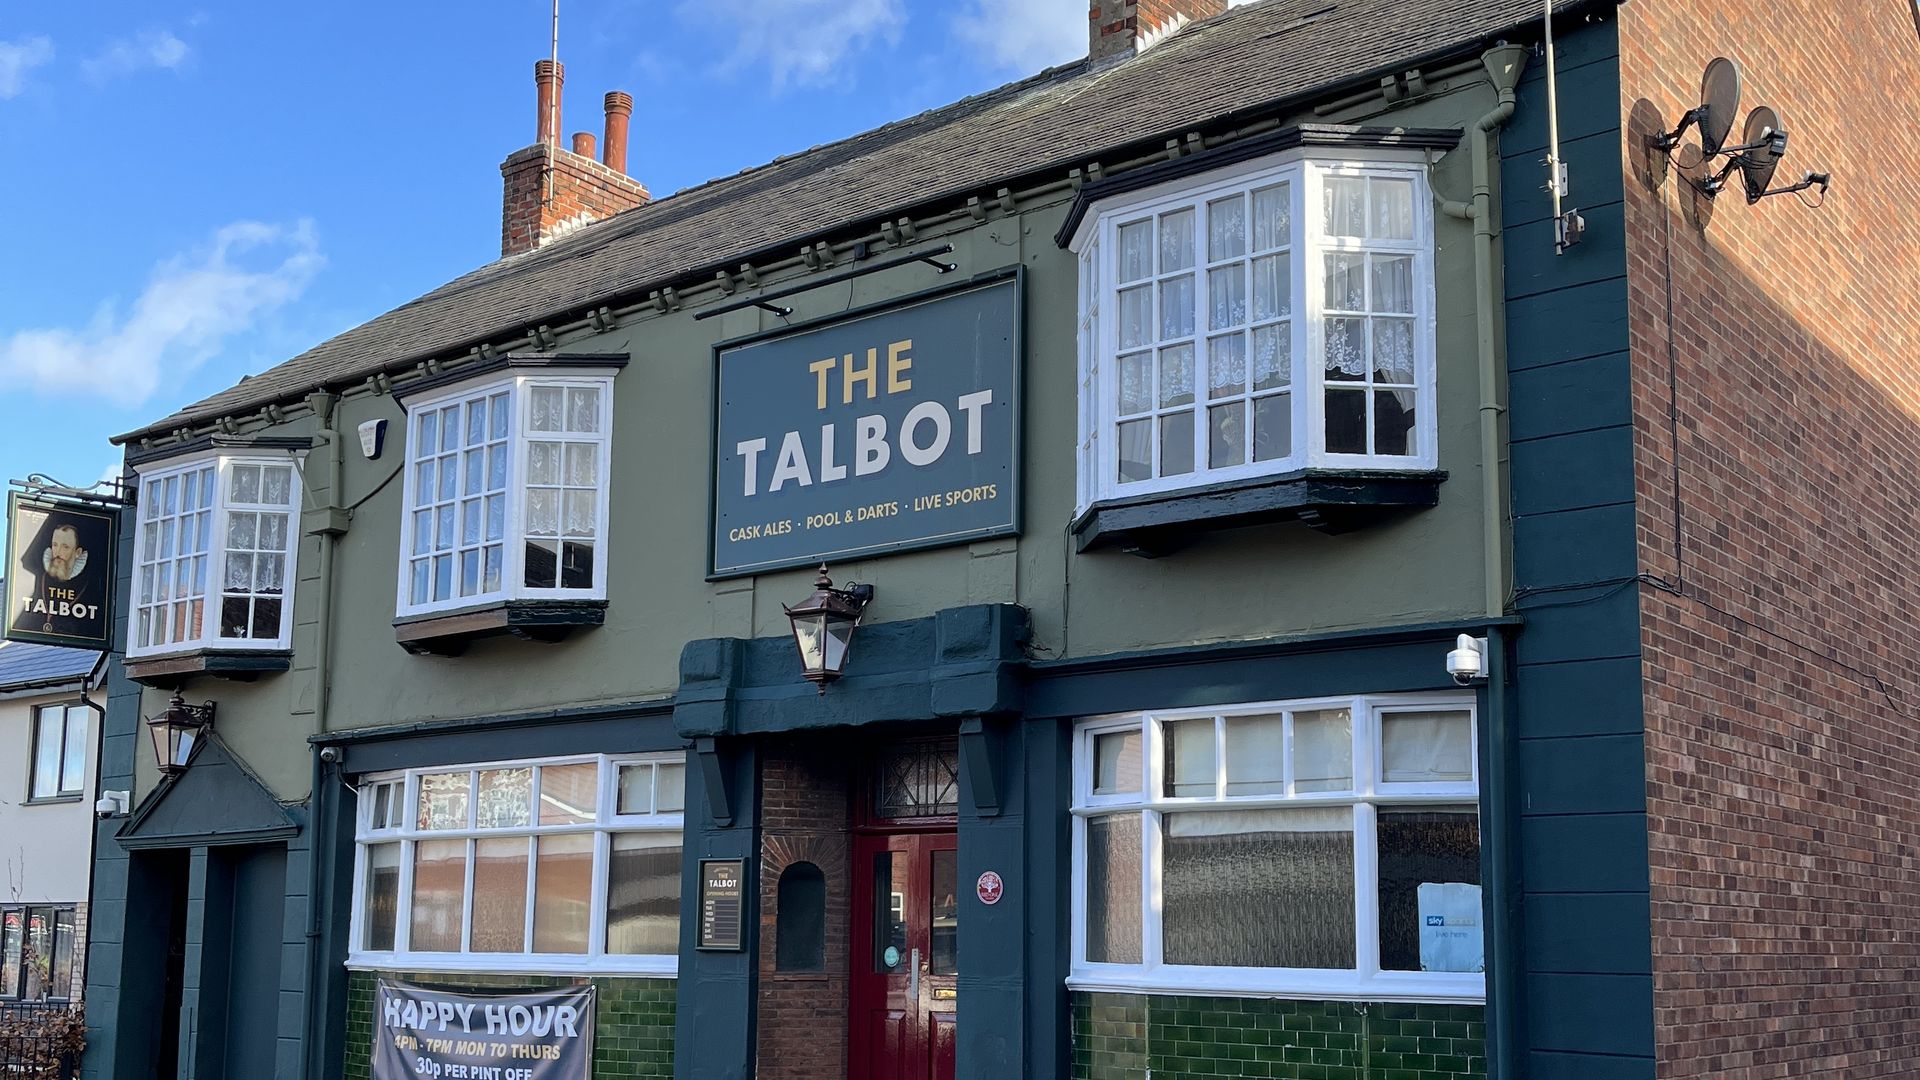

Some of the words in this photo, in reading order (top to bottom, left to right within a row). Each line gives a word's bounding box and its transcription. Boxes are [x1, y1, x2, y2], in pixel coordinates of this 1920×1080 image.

[808, 338, 913, 410] THE
[736, 388, 993, 497] TALBOT
[729, 524, 761, 542] CASK
[763, 519, 792, 537] ALES
[806, 511, 841, 529] POOL
[844, 509, 853, 523] &
[857, 501, 899, 521] DARTS
[914, 493, 941, 511] LIVE
[945, 483, 997, 506] SPORTS
[48, 586, 75, 600] THE
[22, 596, 98, 620] TALBOT
[709, 879, 737, 888] TALBOT
[384, 997, 477, 1034] HAPPY
[484, 1004, 578, 1038] HOUR
[395, 1035, 418, 1051] 4PM
[425, 1038, 453, 1055] 7PM
[455, 1041, 487, 1057] MON
[490, 1042, 506, 1058] TO
[511, 1043, 561, 1060] THURS
[415, 1057, 441, 1079] 30p
[444, 1063, 468, 1079] PER
[471, 1065, 502, 1080] PINT
[505, 1068, 532, 1080] OFF
